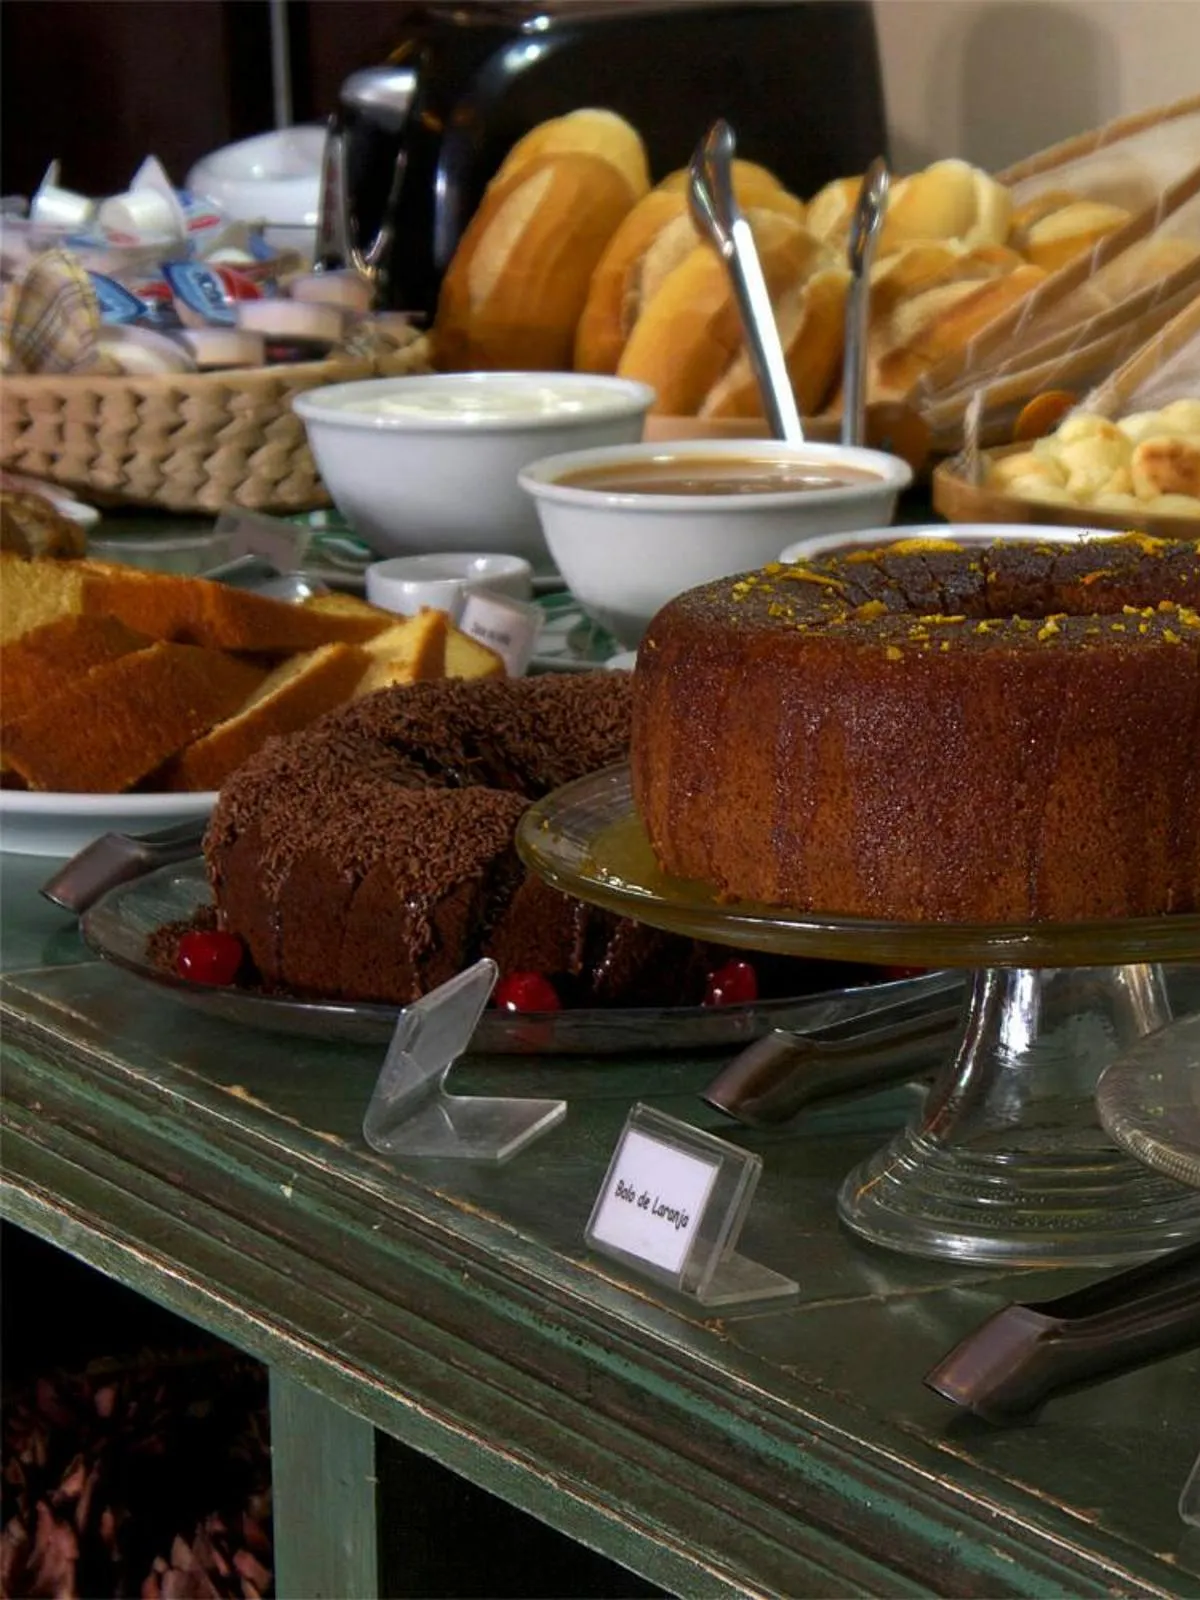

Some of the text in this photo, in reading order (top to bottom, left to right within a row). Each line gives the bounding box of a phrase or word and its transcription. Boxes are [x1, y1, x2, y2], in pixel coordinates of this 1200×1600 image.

[615, 1179, 690, 1230] Bolo de Laranja
